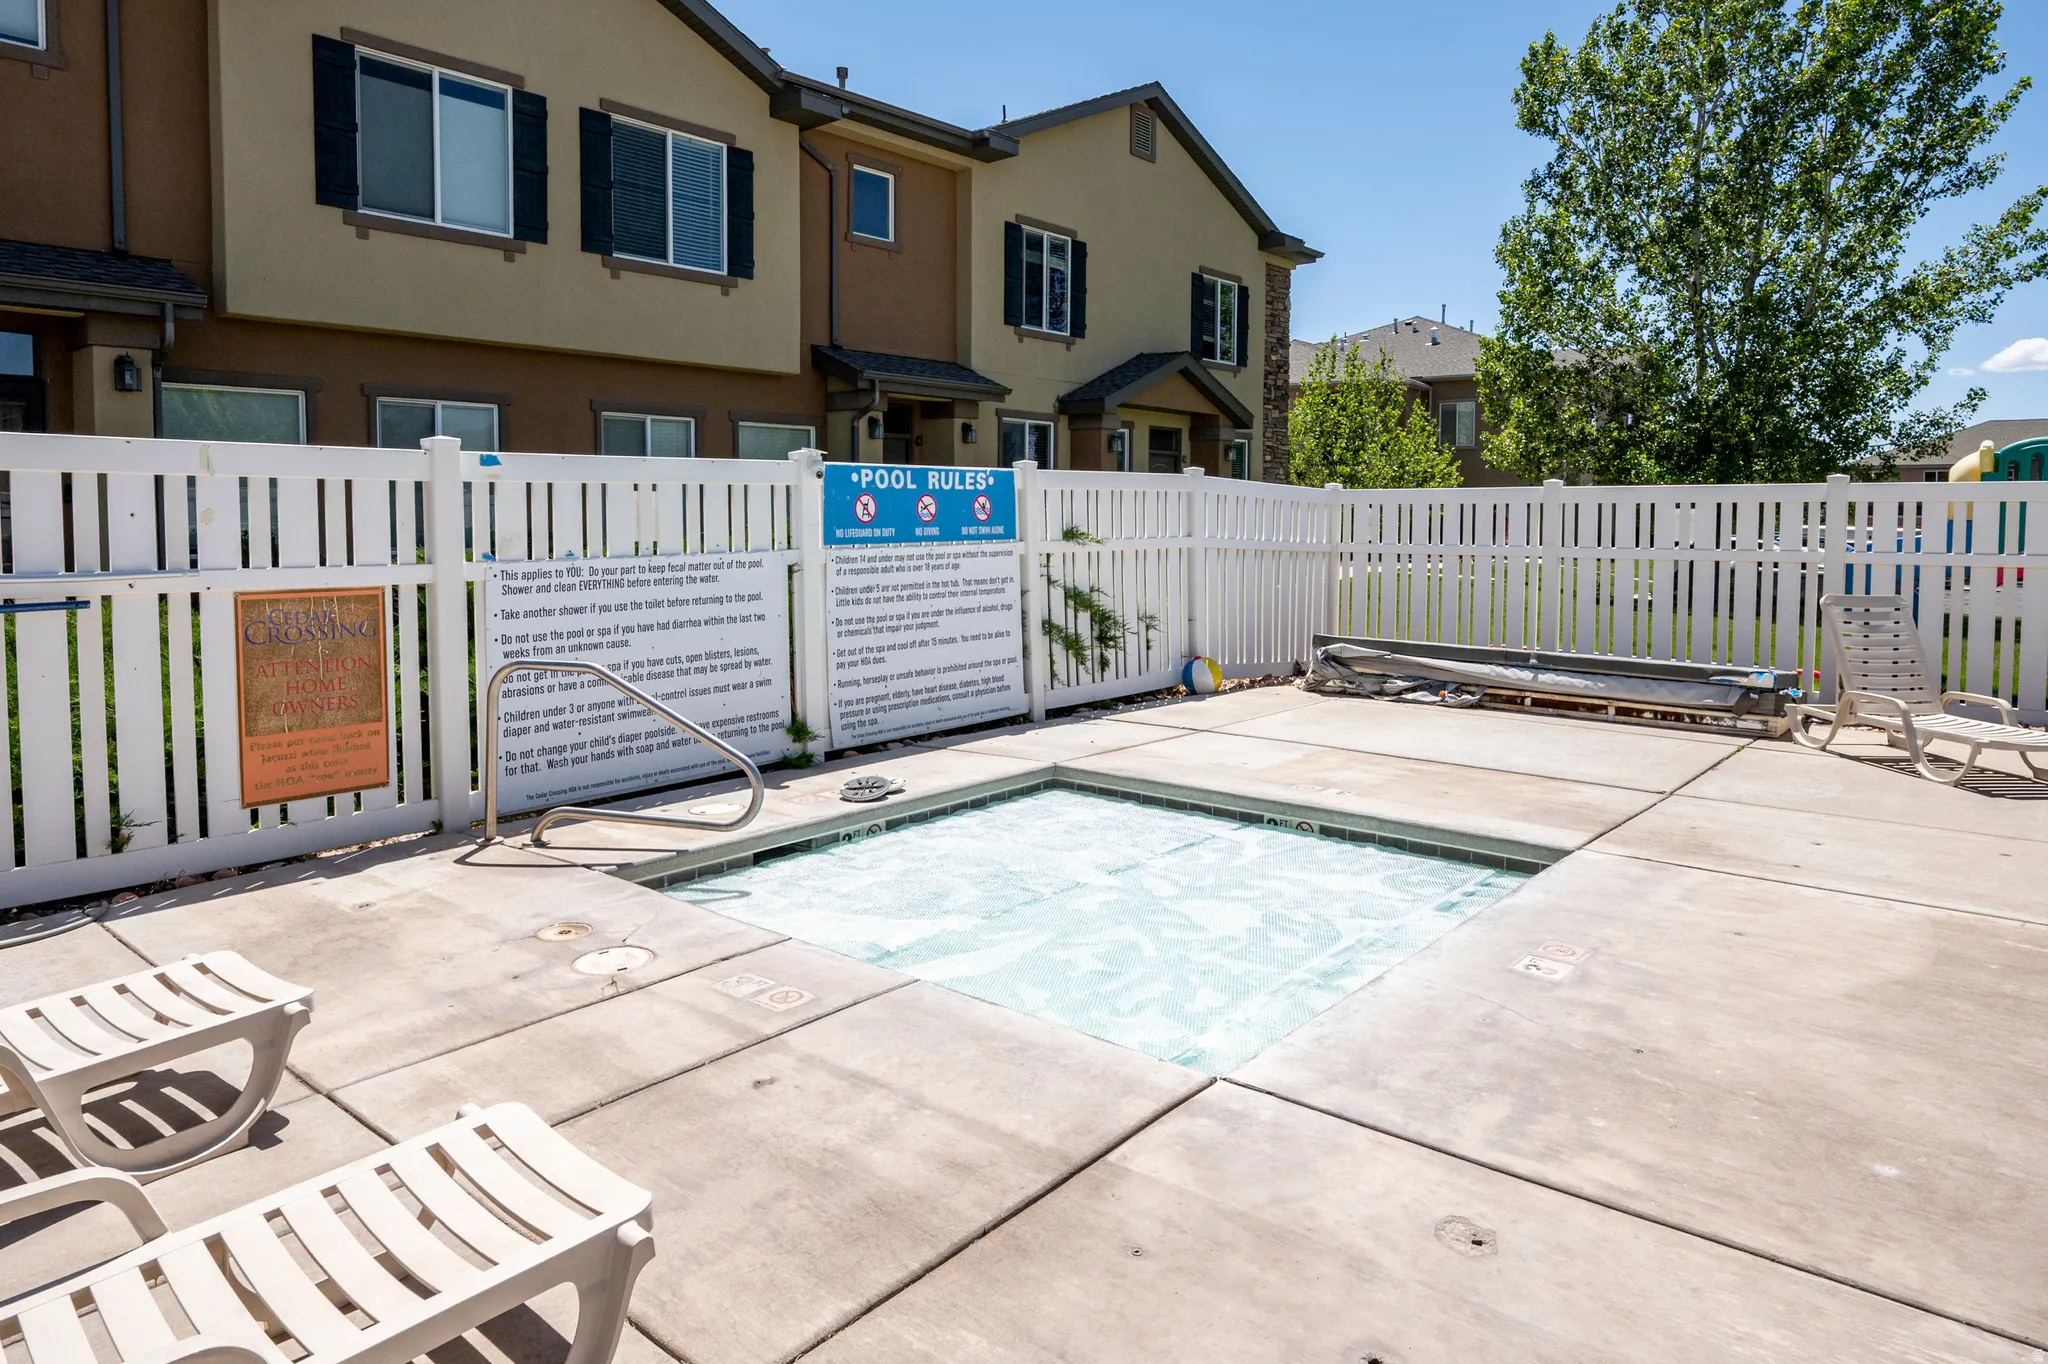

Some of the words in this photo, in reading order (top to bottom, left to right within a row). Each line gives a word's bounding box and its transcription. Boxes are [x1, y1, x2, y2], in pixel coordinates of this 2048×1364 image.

[860, 468, 917, 490] POOL
[928, 471, 987, 490] RULES
[836, 528, 844, 538] NO
[844, 528, 873, 538] LIFEGUARD
[873, 528, 881, 537] ON
[882, 527, 895, 537] DUTY
[915, 527, 923, 536] NO
[923, 526, 940, 536] DIVING
[961, 526, 968, 535] DO
[969, 526, 978, 535] NOT
[978, 526, 991, 535] SWIM
[991, 525, 1005, 534] ALONE
[835, 555, 858, 564] Children
[859, 554, 865, 563] 14
[867, 554, 877, 563] and
[878, 553, 893, 562] under
[894, 554, 905, 563] may
[906, 553, 914, 561] not
[926, 552, 934, 560] the
[935, 551, 946, 560] pool
[952, 552, 961, 560] spa
[962, 550, 979, 558] without
[988, 548, 1013, 558] supervision
[500, 569, 518, 581] This
[521, 568, 552, 582] applies
[555, 568, 563, 578] to
[565, 566, 583, 577] YOU:
[588, 565, 599, 576] Do
[601, 567, 618, 578] your
[620, 565, 636, 576] part
[638, 564, 646, 574] to
[648, 563, 665, 574] keep
[667, 561, 686, 572] fecal
[687, 561, 711, 571] matter
[713, 558, 724, 570] out
[726, 559, 734, 569] of
[735, 559, 746, 569] the
[748, 558, 763, 570] pool.
[835, 567, 842, 576] of
[842, 568, 847, 576] a
[848, 566, 879, 576] responsible
[880, 565, 894, 573] adult
[895, 564, 905, 572] who
[912, 564, 923, 572] over
[924, 562, 930, 571] 18
[931, 563, 944, 572] years
[945, 561, 950, 570] of
[951, 562, 961, 570] age.
[501, 584, 533, 596] Shower
[535, 582, 551, 593] and
[554, 581, 576, 592] clean
[579, 578, 624, 591] EVERYTHING
[627, 577, 651, 588] before
[653, 575, 683, 587] entering
[685, 574, 697, 584] the
[699, 574, 719, 583] water.
[500, 608, 520, 620] Take
[522, 606, 556, 619] another
[558, 604, 587, 616] shower
[590, 602, 596, 613] if
[598, 604, 612, 615] you
[614, 602, 628, 612] use
[630, 599, 643, 611] the
[644, 598, 664, 609] toilet
[666, 596, 690, 607] before
[691, 594, 723, 605] returning
[725, 594, 732, 603] to
[734, 592, 745, 602] the
[747, 591, 763, 603] pool.
[244, 619, 376, 646] CROSSING
[501, 633, 512, 645] Do
[515, 632, 529, 643] not
[532, 632, 547, 642] use
[550, 629, 564, 640] the
[566, 627, 584, 641] pool
[586, 628, 595, 637] or
[597, 627, 611, 638] spa
[613, 623, 619, 634] if
[621, 625, 635, 636] you
[637, 622, 654, 632] have
[656, 619, 670, 631] had
[672, 617, 701, 629] diarrhea
[703, 615, 724, 626] within
[726, 614, 737, 624] the
[739, 613, 752, 623] last
[753, 613, 765, 622] two
[502, 647, 530, 659] weeks
[532, 645, 553, 656] from
[555, 645, 565, 654] an
[568, 641, 604, 653] unknown
[605, 639, 631, 649] cause.
[606, 662, 621, 673] spa
[623, 659, 629, 670] if
[631, 660, 644, 671] you
[646, 657, 664, 667] have
[665, 655, 684, 665] cuts,
[685, 653, 702, 664] open
[704, 650, 732, 660] blisters,
[734, 646, 759, 657] lesions,
[255, 655, 372, 678] ATTENTION
[836, 661, 846, 671] pay
[847, 660, 859, 669] your
[860, 656, 871, 666] HOA
[872, 656, 887, 664] dues.
[837, 677, 862, 688] Running,
[862, 673, 888, 684] horseplay
[889, 673, 895, 681] or
[896, 669, 913, 680] unsafe
[914, 666, 936, 677] behavior
[936, 665, 941, 674] is
[942, 662, 967, 675] prohibited
[968, 659, 983, 669] around
[984, 659, 992, 667] the
[992, 659, 1001, 667] spa
[1007, 655, 1018, 665] pool.
[286, 676, 346, 695] HOME
[517, 672, 531, 682] not
[534, 670, 548, 683] get
[272, 694, 359, 716] OWNERS
[504, 709, 540, 723] Children
[542, 705, 566, 718] under
[569, 703, 574, 714] 3
[576, 704, 585, 713] or
[587, 699, 615, 711] anyone
[617, 694, 634, 707] with
